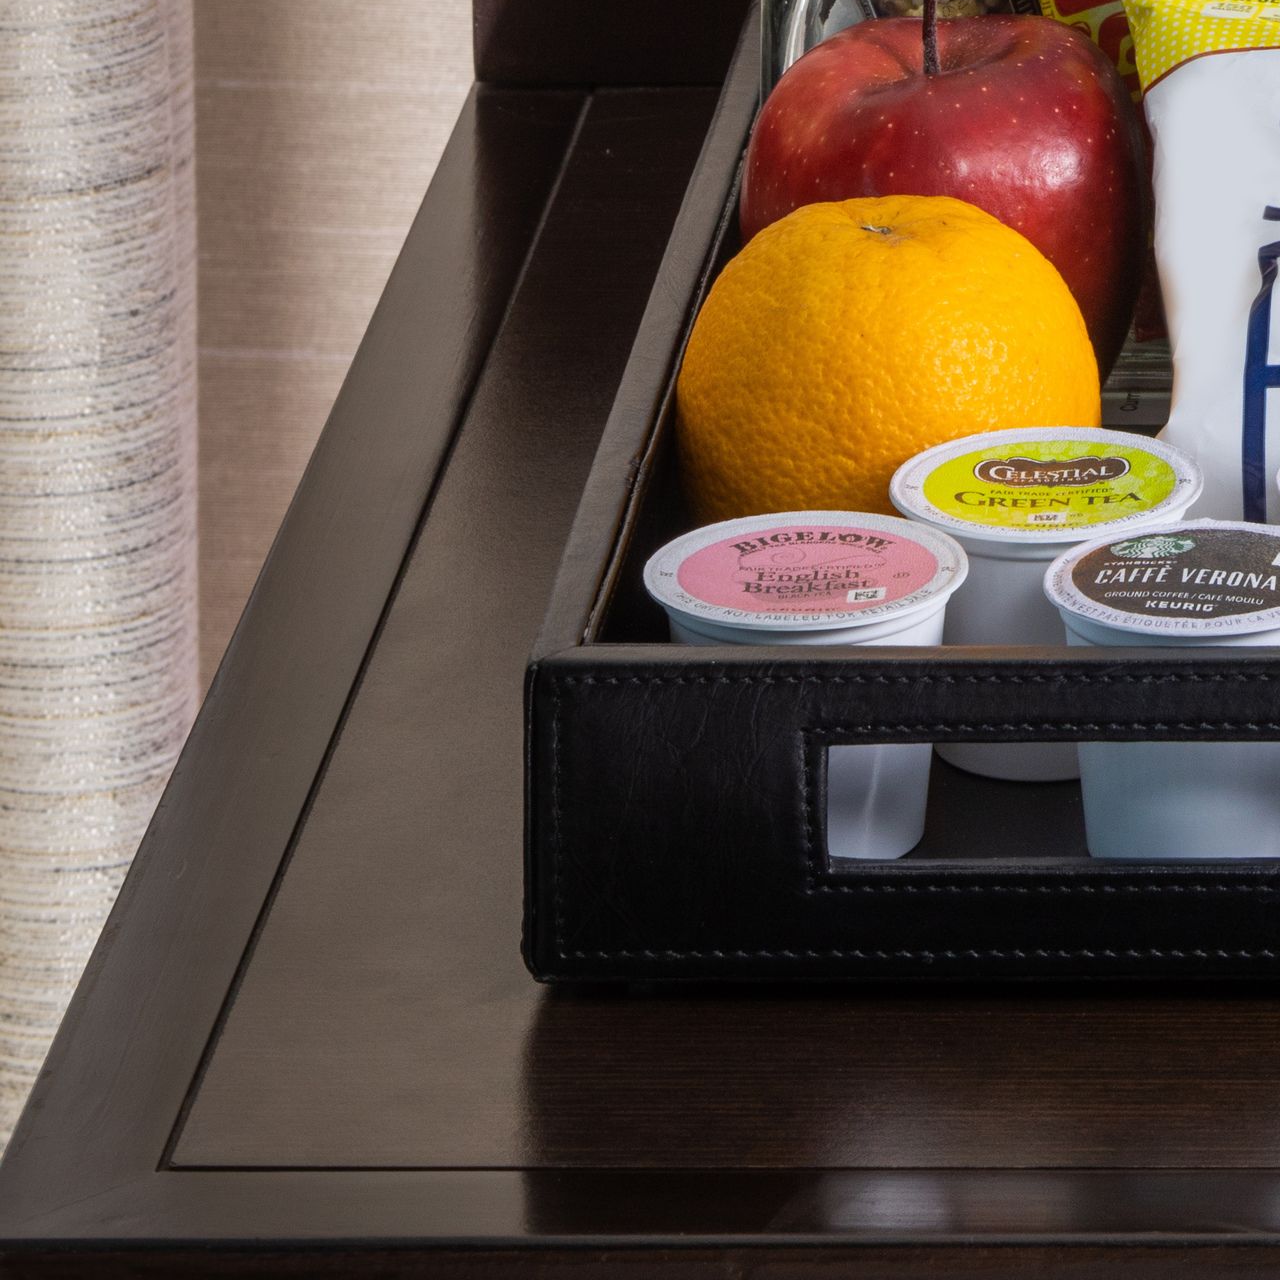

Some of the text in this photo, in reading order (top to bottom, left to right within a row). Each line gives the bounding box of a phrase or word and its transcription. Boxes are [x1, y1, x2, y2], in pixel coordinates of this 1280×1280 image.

[988, 465, 1114, 481] CELESTIAL
[954, 491, 1143, 508] GREEN TEA
[729, 531, 897, 554] BIGELOW
[757, 570, 861, 584] English
[1094, 564, 1277, 591] CAFFÈ VERONA
[742, 580, 872, 595] Breakfast
[1104, 590, 1151, 600] GROUND
[1151, 591, 1190, 600] COFFEE
[1227, 596, 1265, 606] MOULU
[1145, 600, 1214, 611] KEURIG
